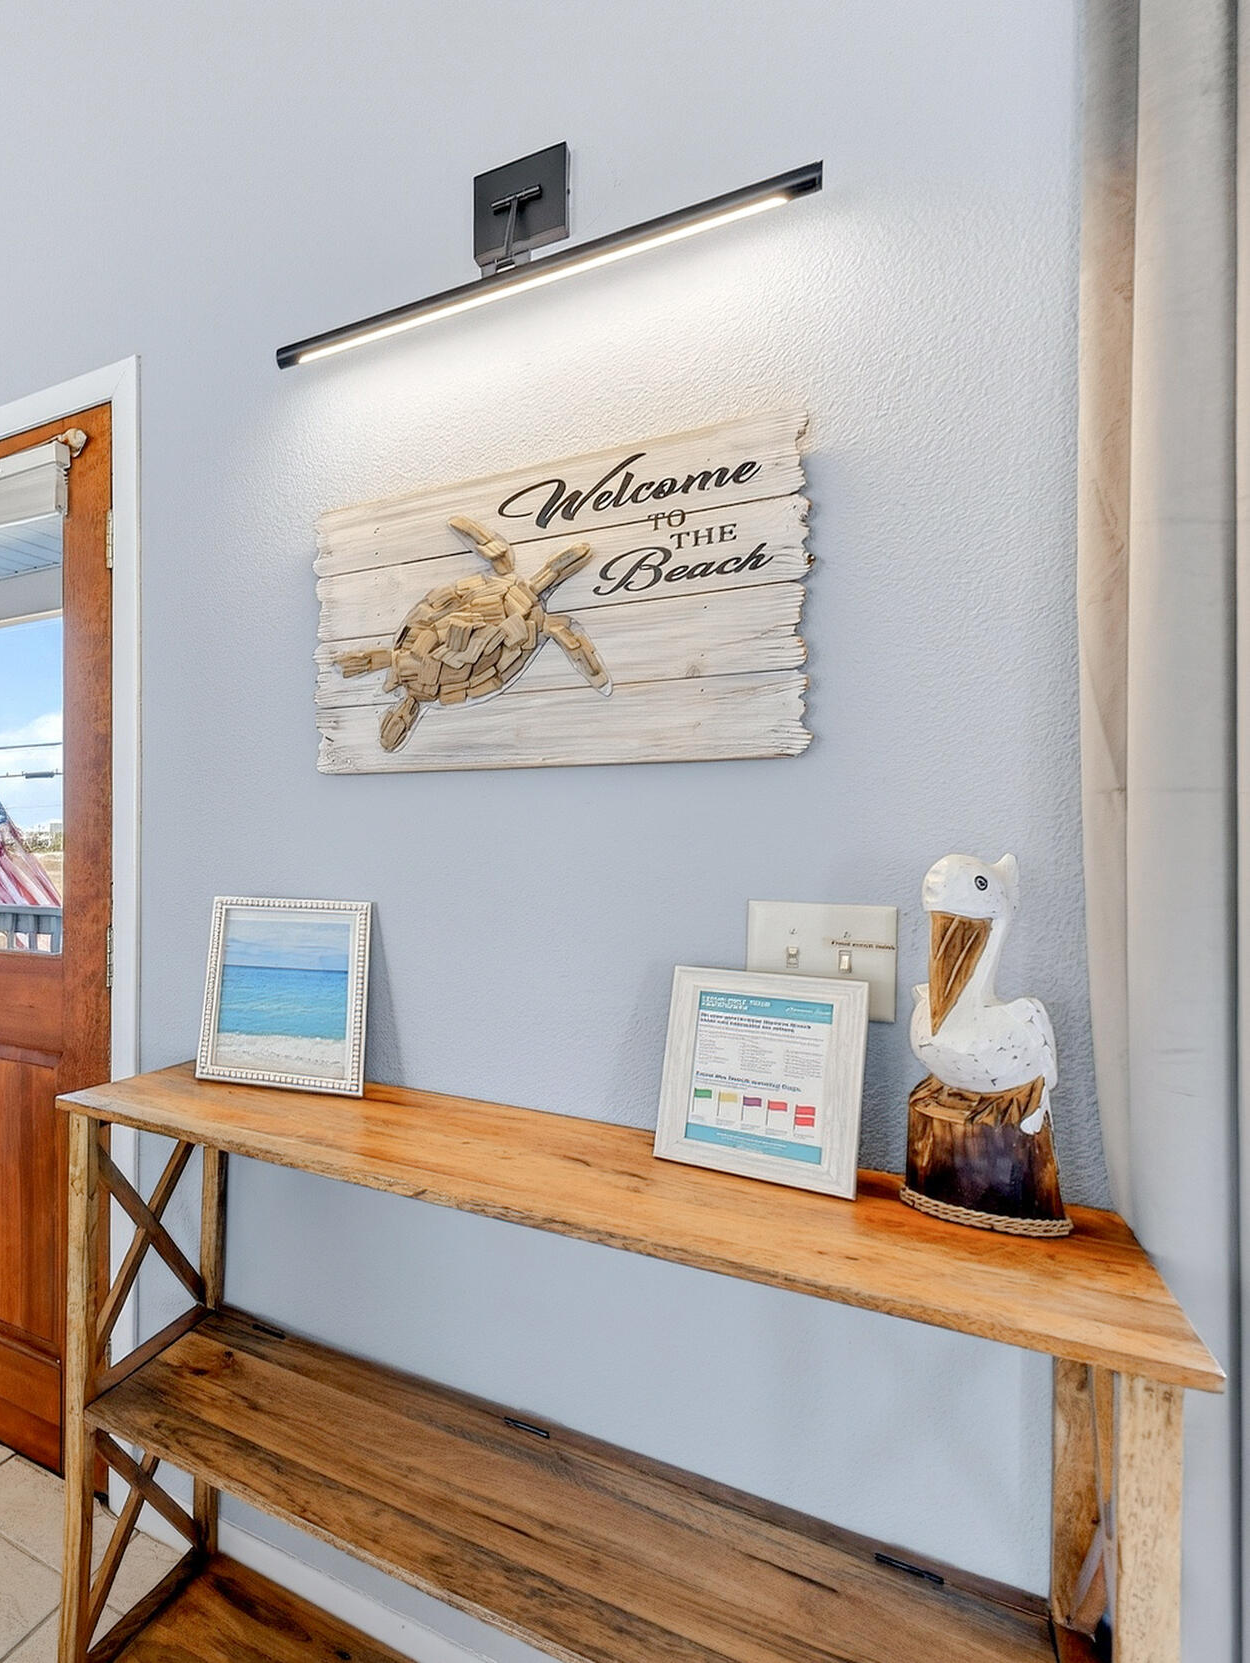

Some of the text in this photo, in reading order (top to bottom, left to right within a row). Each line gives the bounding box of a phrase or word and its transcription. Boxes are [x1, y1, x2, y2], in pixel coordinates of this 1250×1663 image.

[497, 452, 762, 529] Welcome
[648, 509, 686, 531] TO
[670, 523, 738, 550] THE
[593, 543, 774, 596] Beach
